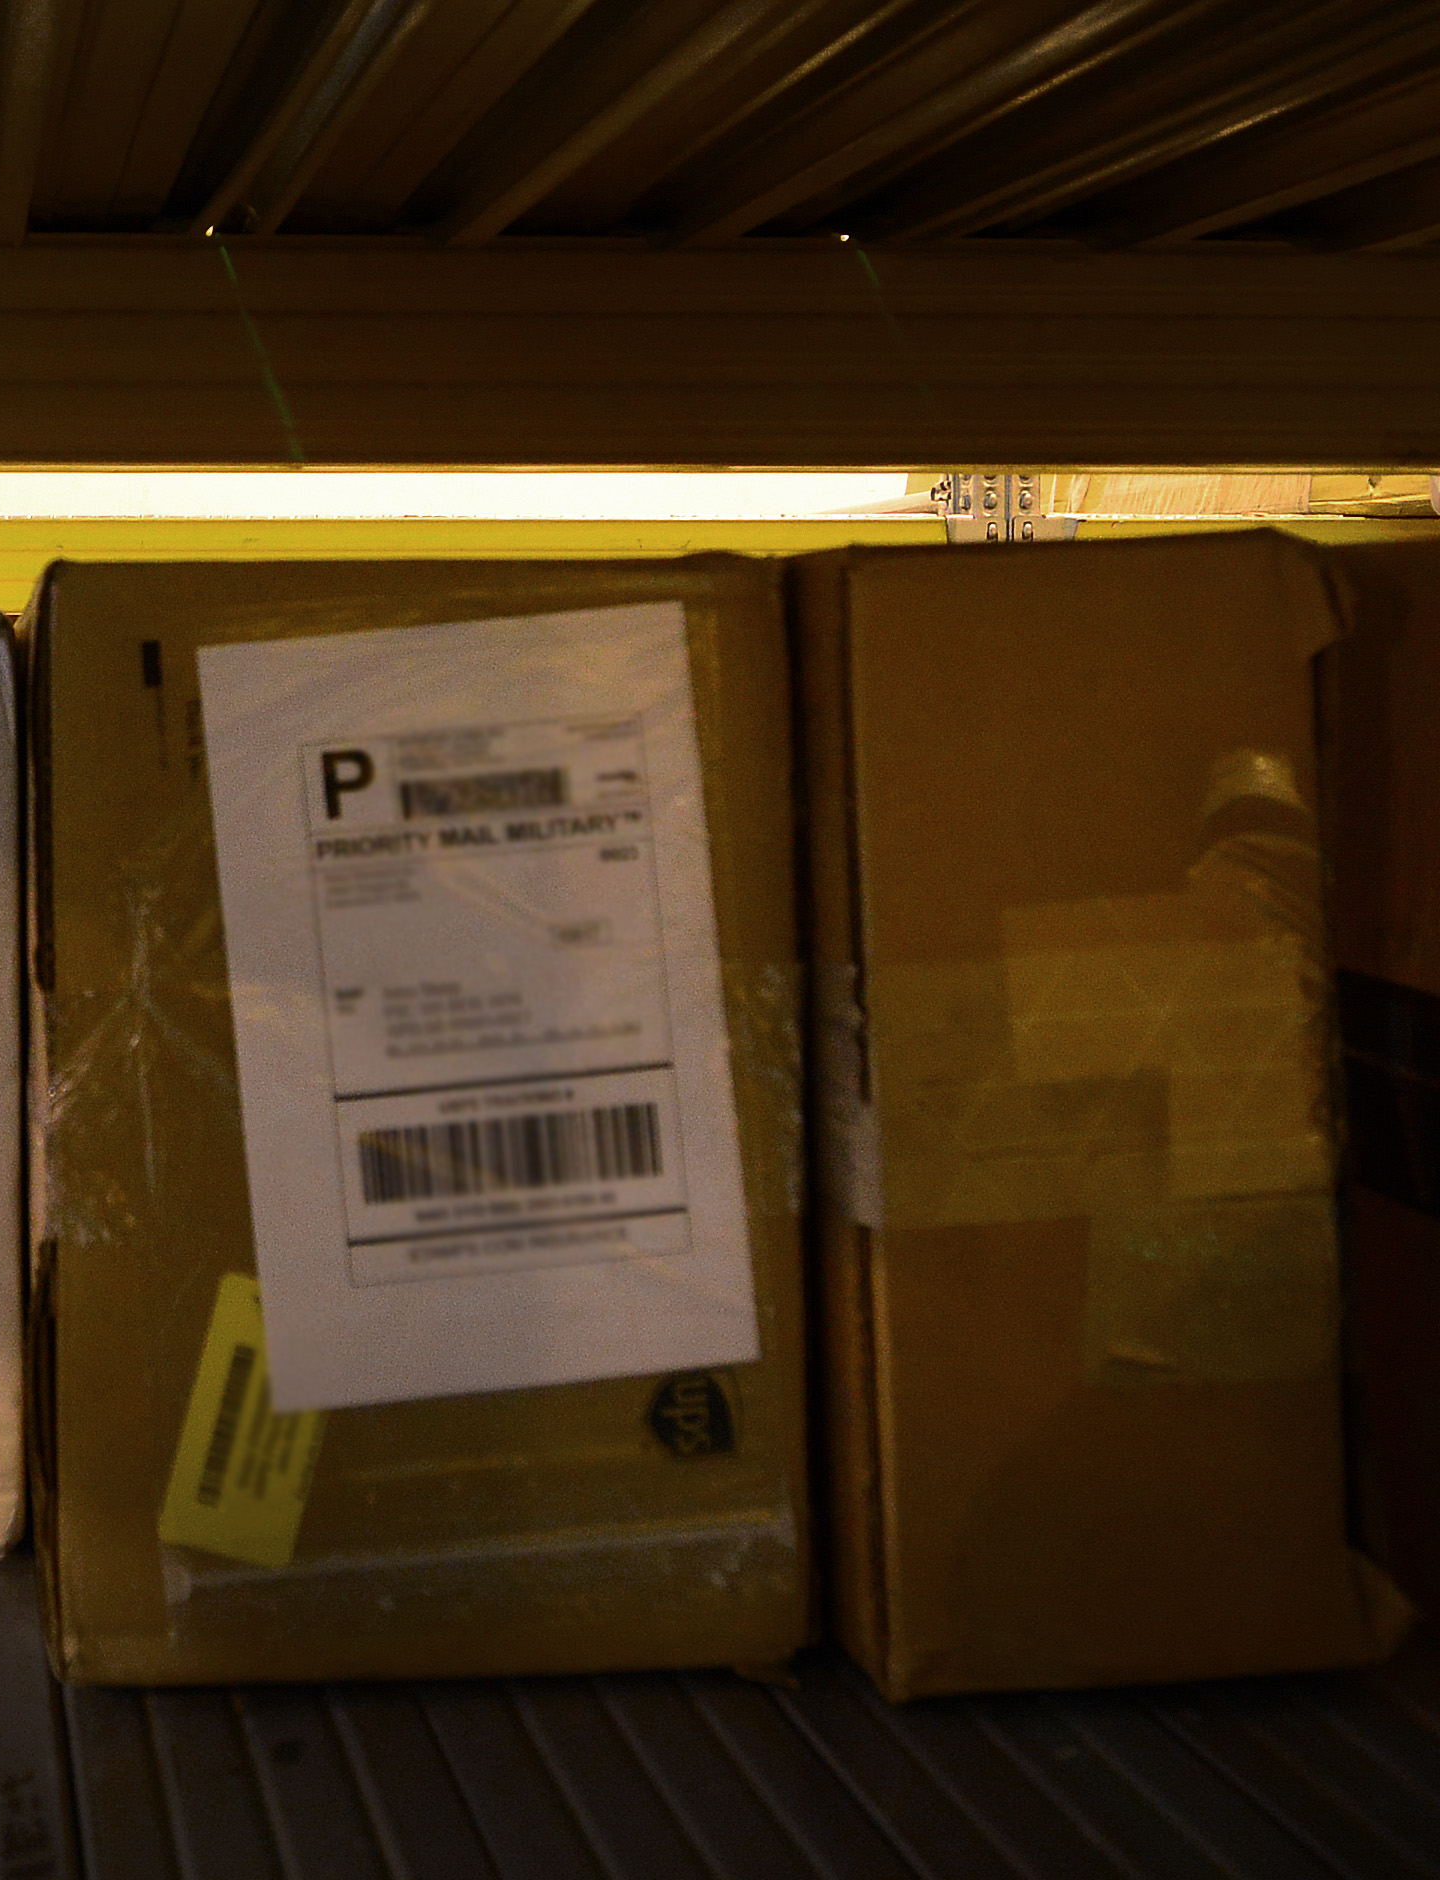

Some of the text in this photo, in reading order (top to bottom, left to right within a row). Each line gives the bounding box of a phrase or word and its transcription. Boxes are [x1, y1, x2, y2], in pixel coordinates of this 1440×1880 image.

[320, 749, 375, 821] P
[316, 831, 431, 861] PRIORITY
[438, 825, 500, 848] MAIL
